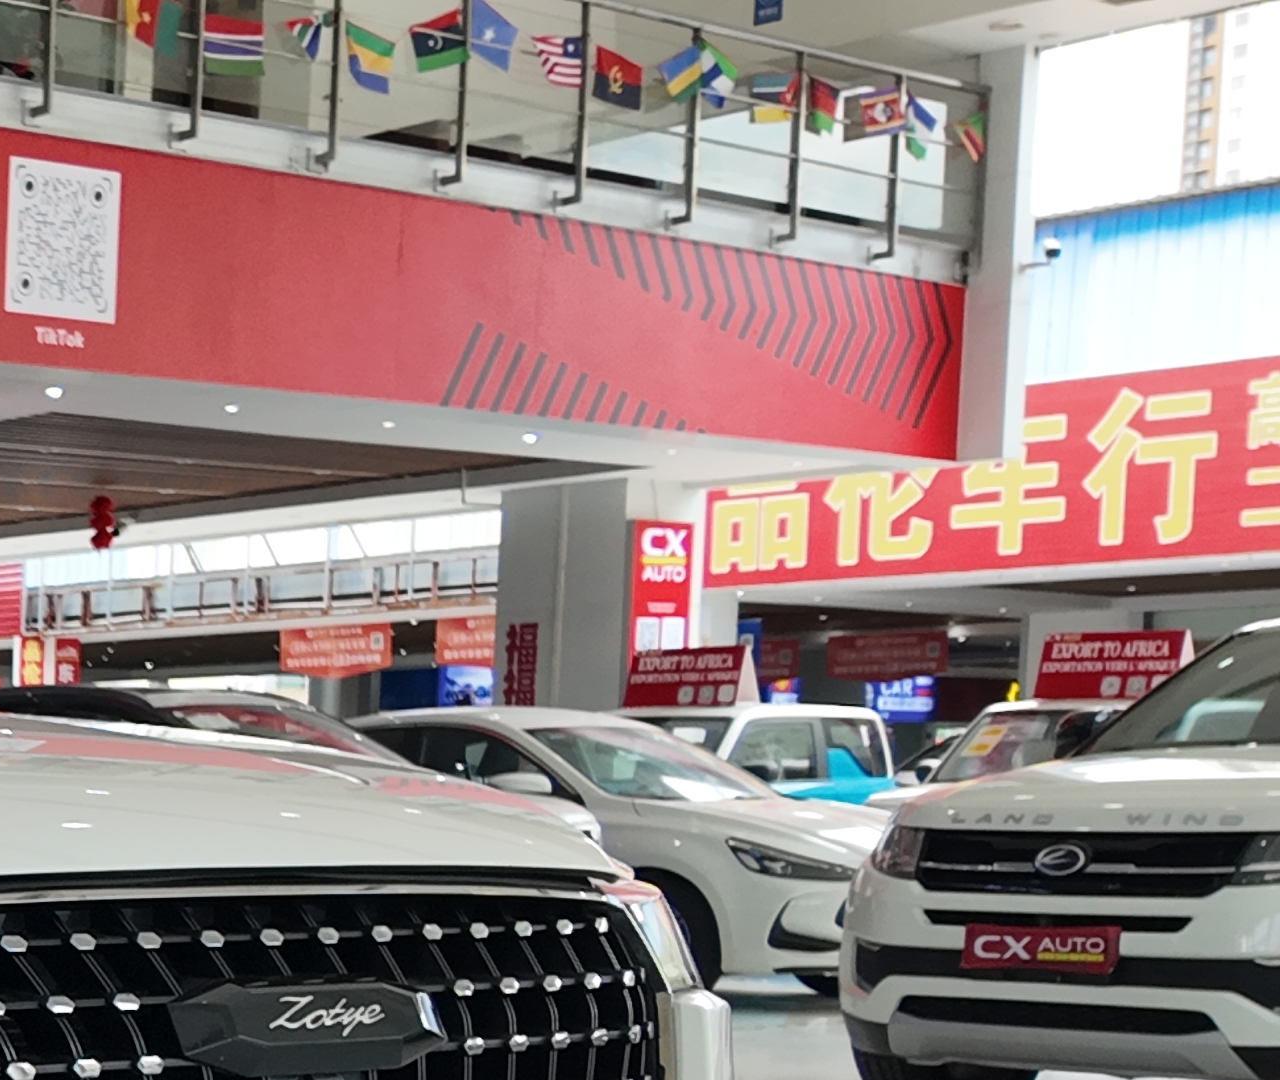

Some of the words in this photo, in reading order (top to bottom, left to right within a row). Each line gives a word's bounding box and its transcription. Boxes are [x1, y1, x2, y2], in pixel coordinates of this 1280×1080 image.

[34, 325, 85, 349] TikTok
[641, 527, 688, 557] CX
[641, 565, 687, 583] AUTO
[1051, 642, 1101, 659] EXPORT
[1101, 641, 1122, 658] TO
[1122, 640, 1170, 658] AFRICA
[638, 656, 679, 671] EXPORT
[680, 655, 695, 670] TO
[695, 653, 733, 669] AFRICA
[950, 813, 1054, 826] LAND
[1126, 813, 1245, 827] WIND
[973, 935, 1033, 961] CX
[1036, 937, 1106, 954] AUTO
[268, 995, 385, 1037] Zotye
